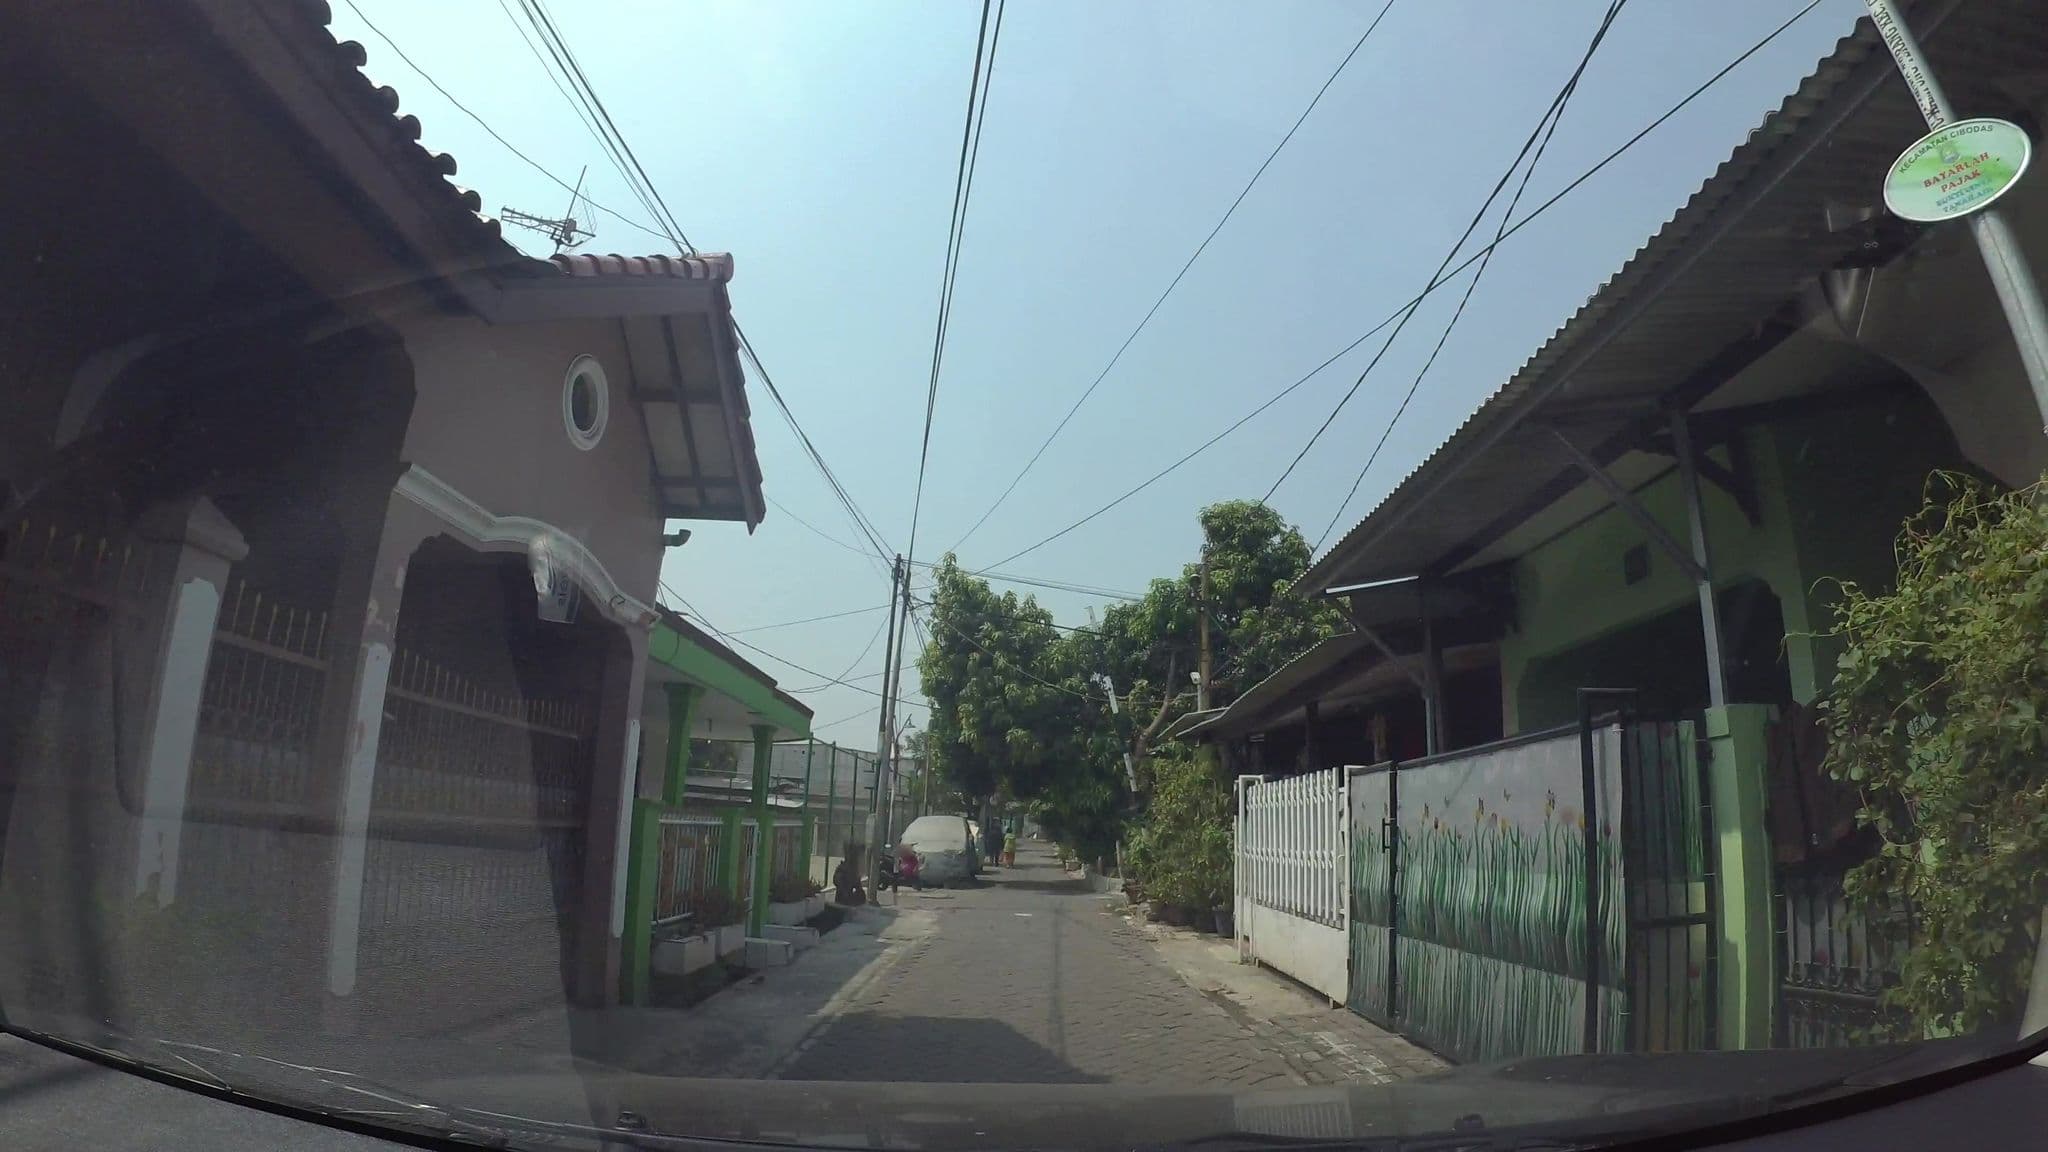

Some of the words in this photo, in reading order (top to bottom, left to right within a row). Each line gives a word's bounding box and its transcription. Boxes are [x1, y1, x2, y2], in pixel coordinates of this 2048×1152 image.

[1900, 135, 1949, 174] KECAMATAN
[1950, 124, 1994, 139] CIBODAS
[1923, 151, 1990, 188] BAYARLAH
[1940, 169, 1981, 193] PAJAK
